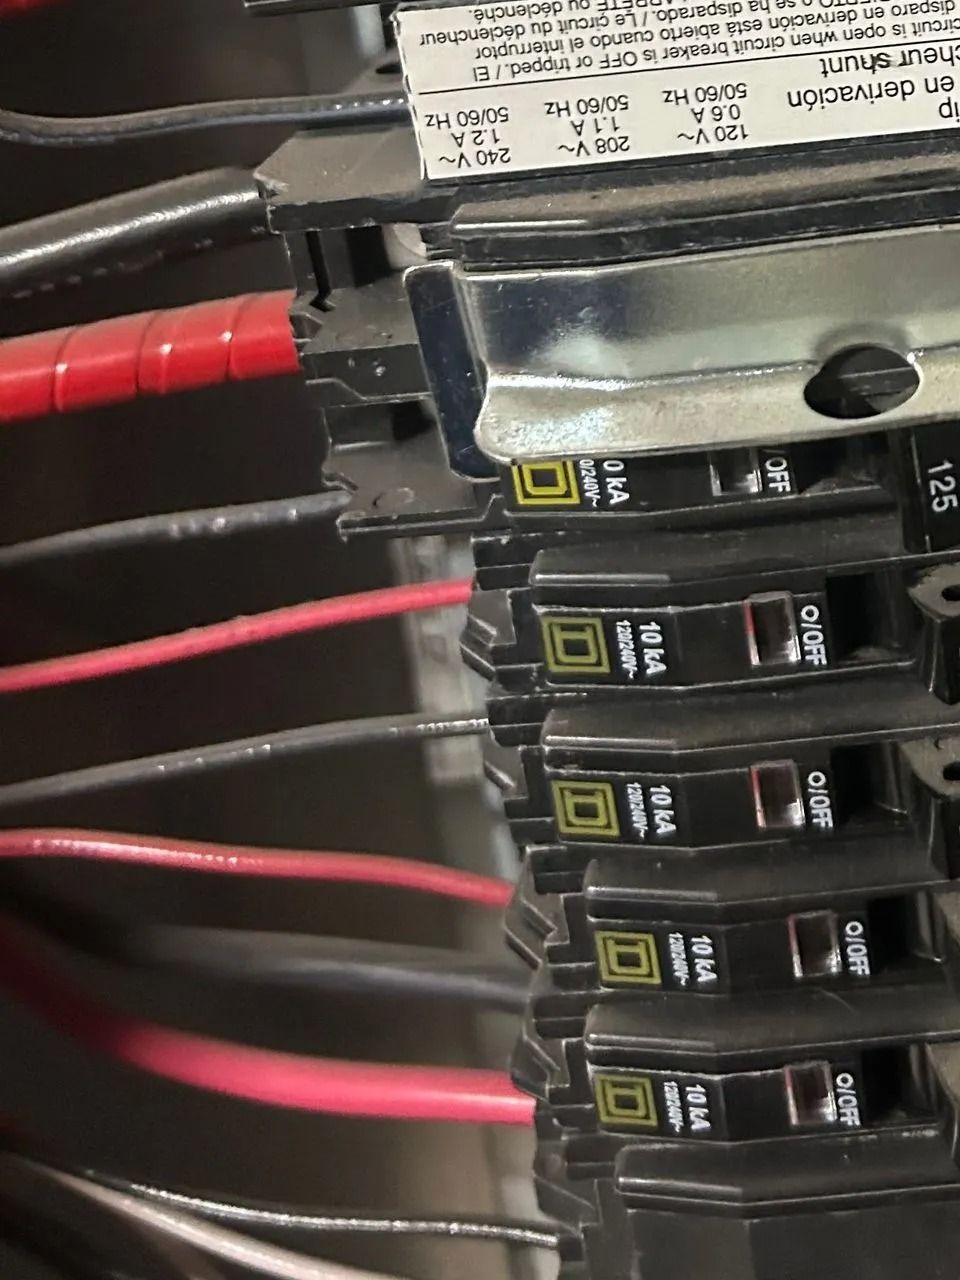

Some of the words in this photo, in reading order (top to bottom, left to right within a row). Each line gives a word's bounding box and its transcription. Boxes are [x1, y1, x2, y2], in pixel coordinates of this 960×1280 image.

[467, 0, 563, 25] déclenché.
[612, 12, 637, 29] Le
[650, 0, 743, 25] disparado.
[767, 8, 858, 32] derivación
[861, 5, 885, 19] en
[529, 20, 553, 37] du
[555, 14, 611, 35] circuit
[658, 22, 720, 42] abierto
[724, 18, 763, 37] está
[841, 22, 886, 40] open
[890, 23, 907, 39] is
[419, 23, 526, 47] déclencheur
[567, 36, 584, 53] el
[588, 29, 654, 50] cuando
[731, 35, 785, 55] circuit
[788, 30, 840, 47] when
[474, 38, 565, 60] interruptor
[640, 48, 658, 64] is
[660, 41, 729, 61] breaker
[504, 54, 571, 79] tripped.
[574, 54, 593, 68] or
[597, 50, 638, 69] OFF
[817, 50, 893, 79] shunt
[472, 65, 491, 82] El
[693, 82, 747, 103] 50/60
[923, 75, 954, 93] en
[575, 94, 629, 115] 50/60
[661, 88, 689, 105] Hz
[786, 79, 915, 111] derivación
[455, 106, 509, 127] 50/60
[543, 99, 571, 118] Hz
[689, 106, 705, 124] A
[709, 103, 741, 122] 0.6
[423, 112, 451, 130] Hz
[569, 118, 584, 136] A
[593, 115, 620, 134] 1.1
[450, 131, 465, 148] A
[469, 127, 500, 146] 1.2
[713, 123, 749, 142] 120
[593, 135, 630, 154] 208
[475, 147, 511, 166] 240
[605, 477, 630, 504] kA
[928, 460, 958, 513] 125
[639, 622, 660, 646] 10
[800, 605, 826, 666] O/OFF
[642, 649, 668, 677] kA
[650, 785, 672, 806] 10
[806, 771, 832, 831] O/OFF
[654, 809, 678, 835] kA
[690, 935, 712, 956] 10
[845, 921, 870, 975] O/OFF
[695, 958, 718, 982] kA
[685, 1084, 706, 1105] 10
[836, 1072, 861, 1126] O/OFF
[690, 1108, 709, 1130] kA
